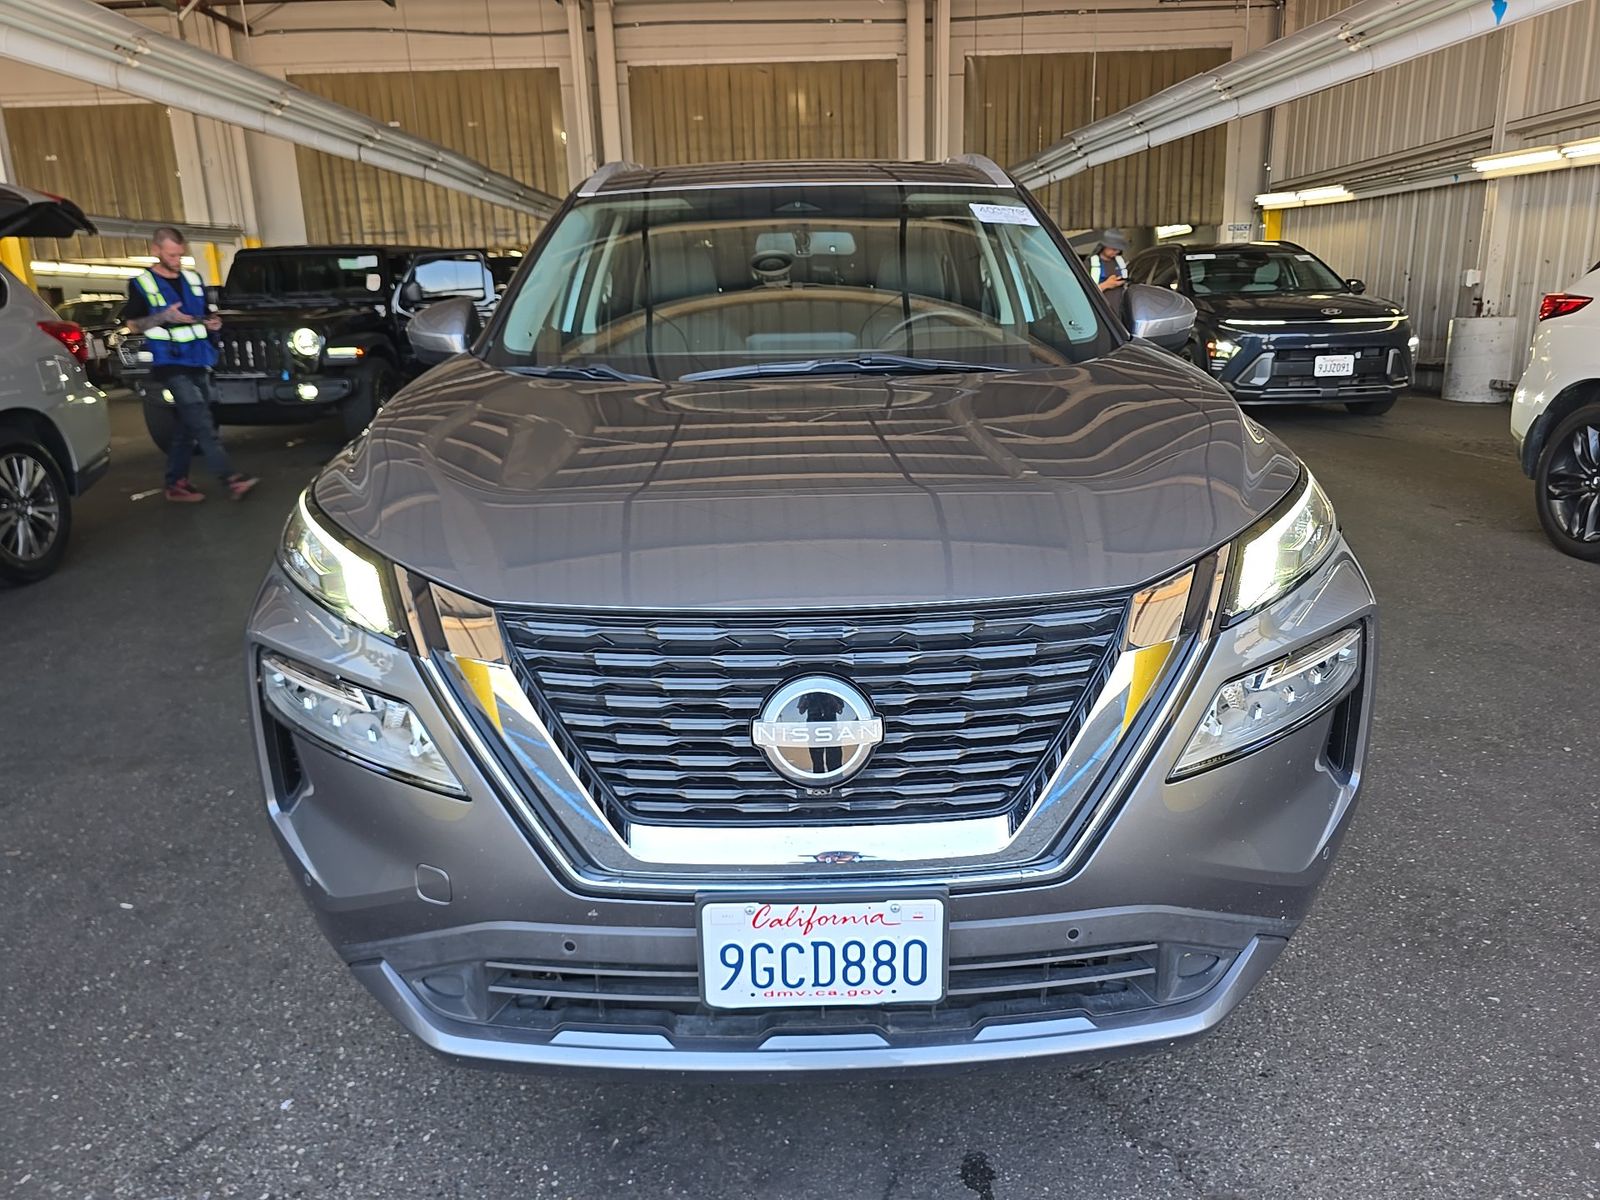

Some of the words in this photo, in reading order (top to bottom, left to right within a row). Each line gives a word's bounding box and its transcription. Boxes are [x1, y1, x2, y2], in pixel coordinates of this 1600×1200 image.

[757, 723, 878, 742] NISSAN
[752, 904, 901, 935] California
[720, 939, 927, 990] 9GCD880
[763, 988, 885, 998] dmv.ca.gov
